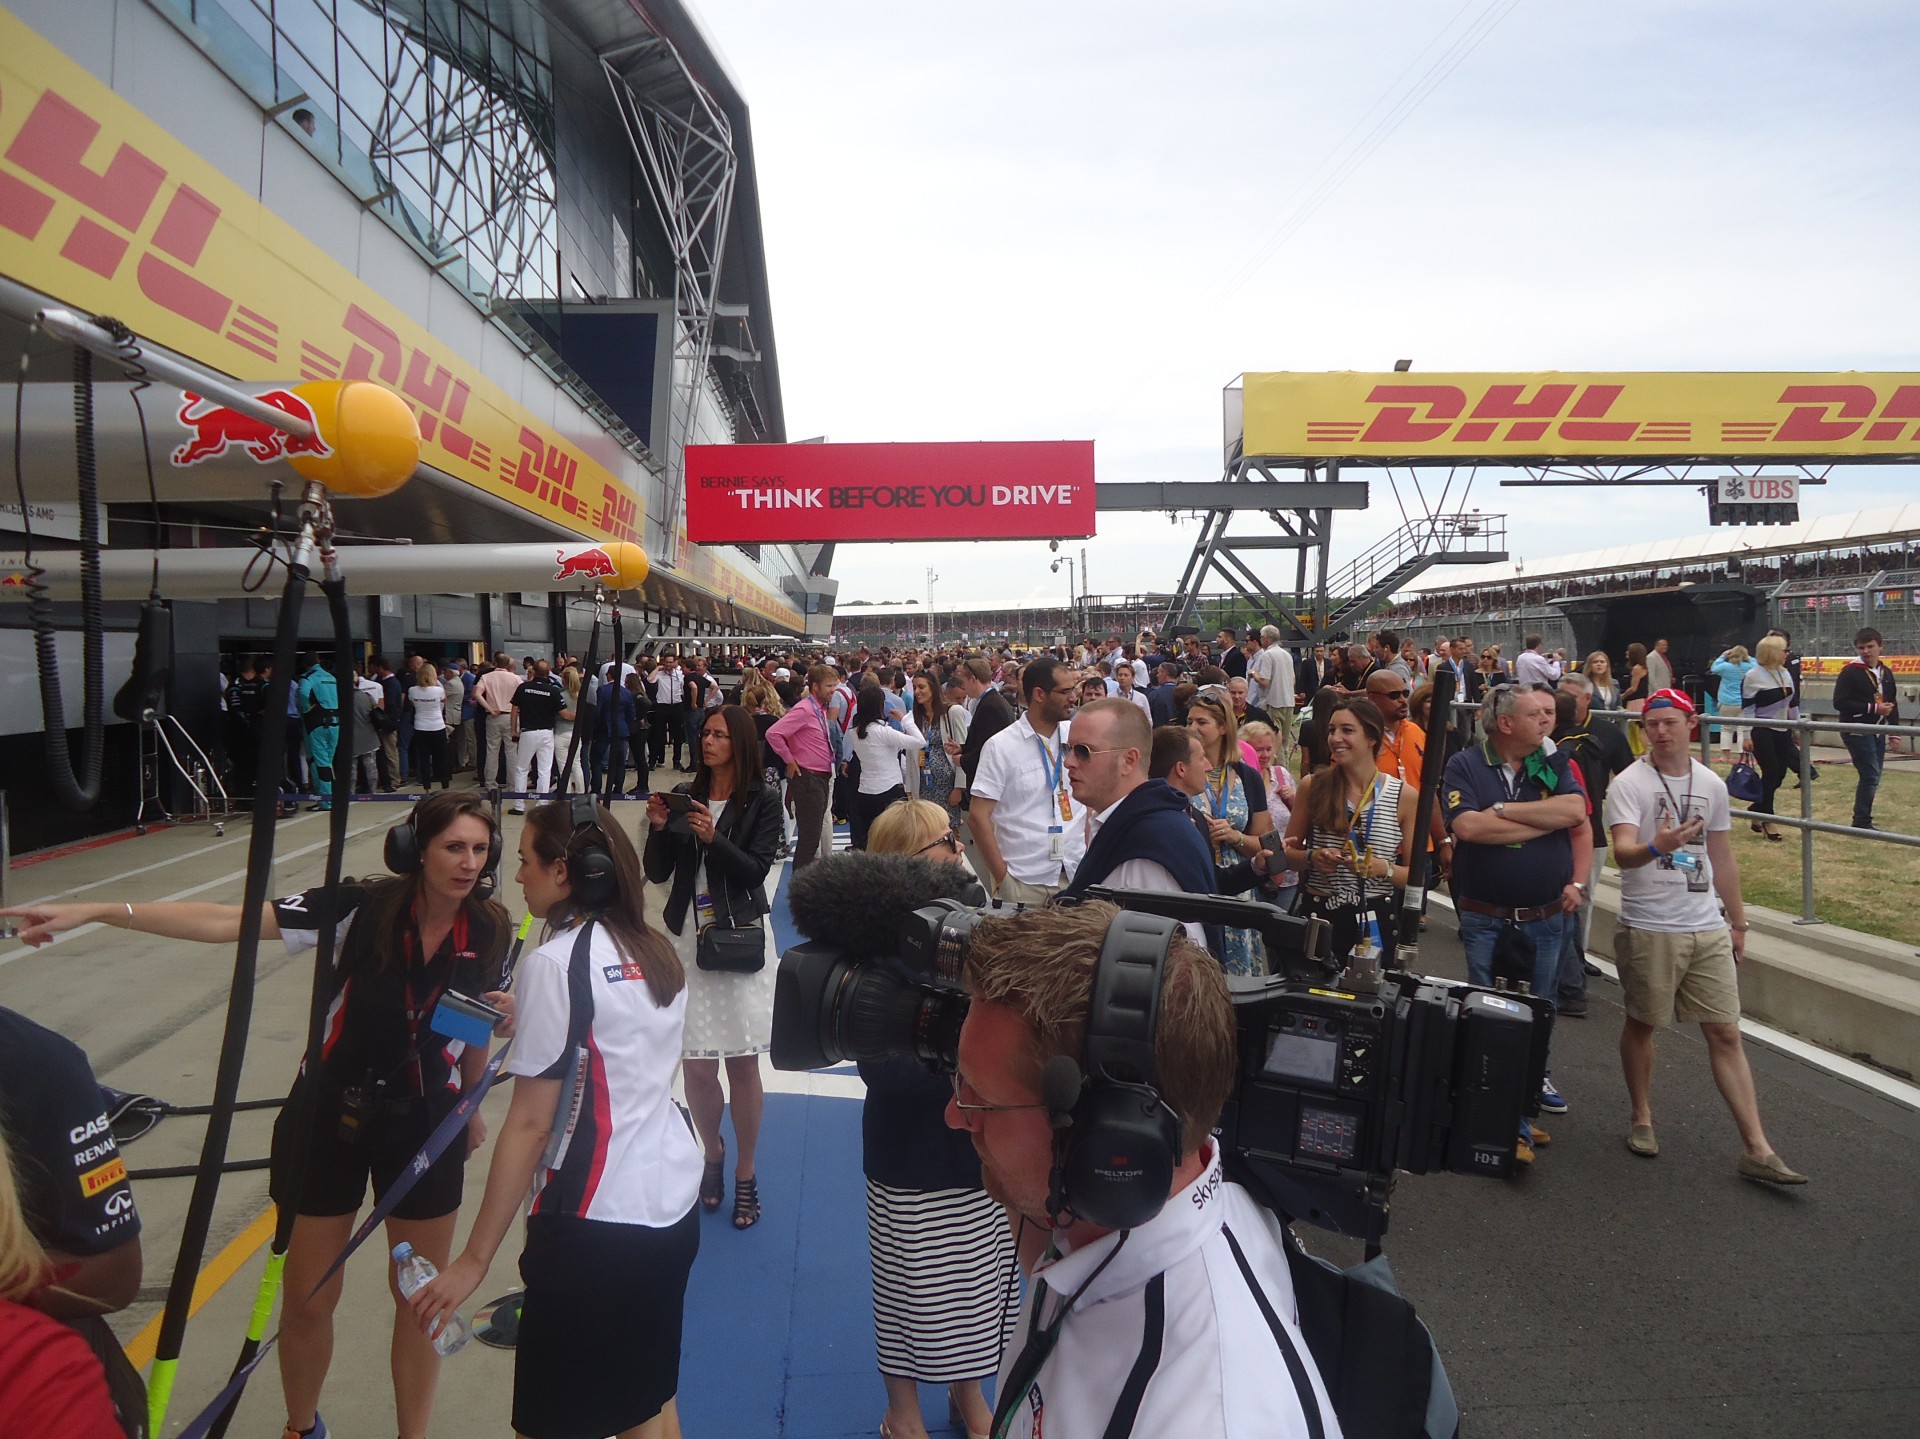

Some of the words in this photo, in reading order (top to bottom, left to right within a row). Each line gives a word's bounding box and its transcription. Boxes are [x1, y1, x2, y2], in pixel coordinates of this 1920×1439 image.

[342, 302, 474, 462] DHL
[1359, 384, 1642, 442] DHL
[514, 425, 580, 516] DHL
[700, 475, 748, 489] BERNIE
[828, 484, 927, 509] BEFORE
[927, 484, 987, 508] YOU
[1748, 479, 1794, 500] UBS
[36, 507, 55, 521] AMG
[601, 483, 638, 545] DHL
[606, 967, 623, 981] sky
[69, 1112, 110, 1145] CAS
[1094, 1168, 1144, 1178] PELTOR
